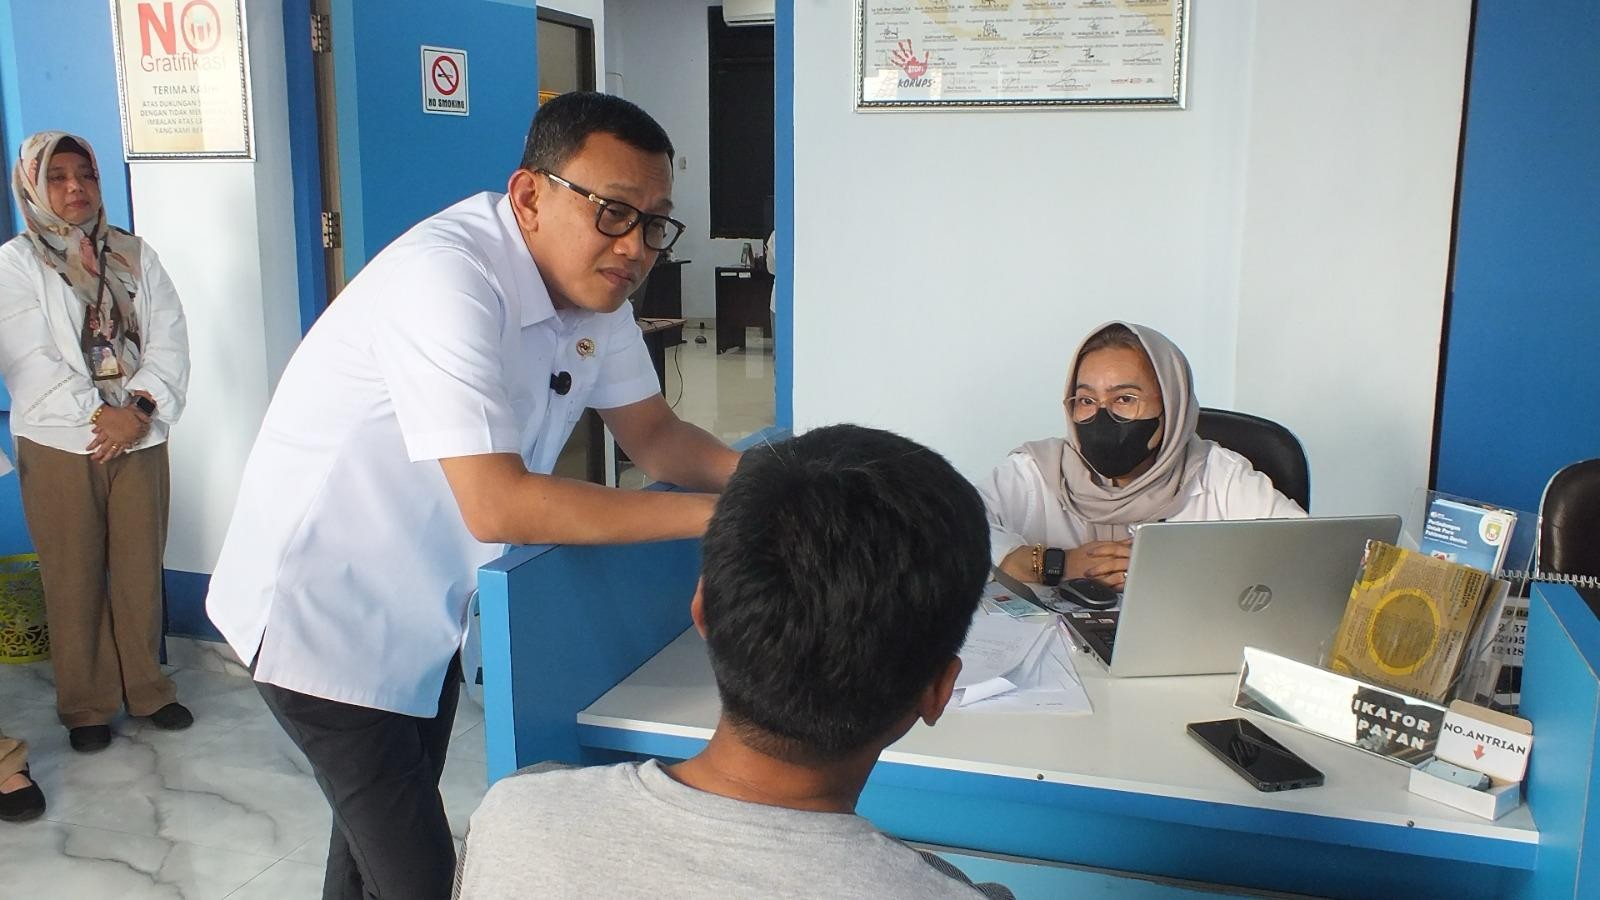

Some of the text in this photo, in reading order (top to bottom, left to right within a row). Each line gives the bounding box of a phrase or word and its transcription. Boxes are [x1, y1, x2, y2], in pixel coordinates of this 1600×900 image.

[153, 85, 188, 95] TERIMA
[428, 98, 465, 109] NO SMOKING
[1353, 699, 1430, 733] IKATOR
[1358, 719, 1425, 750] PATAN
[1443, 721, 1526, 755] NO.ANTRIAN
